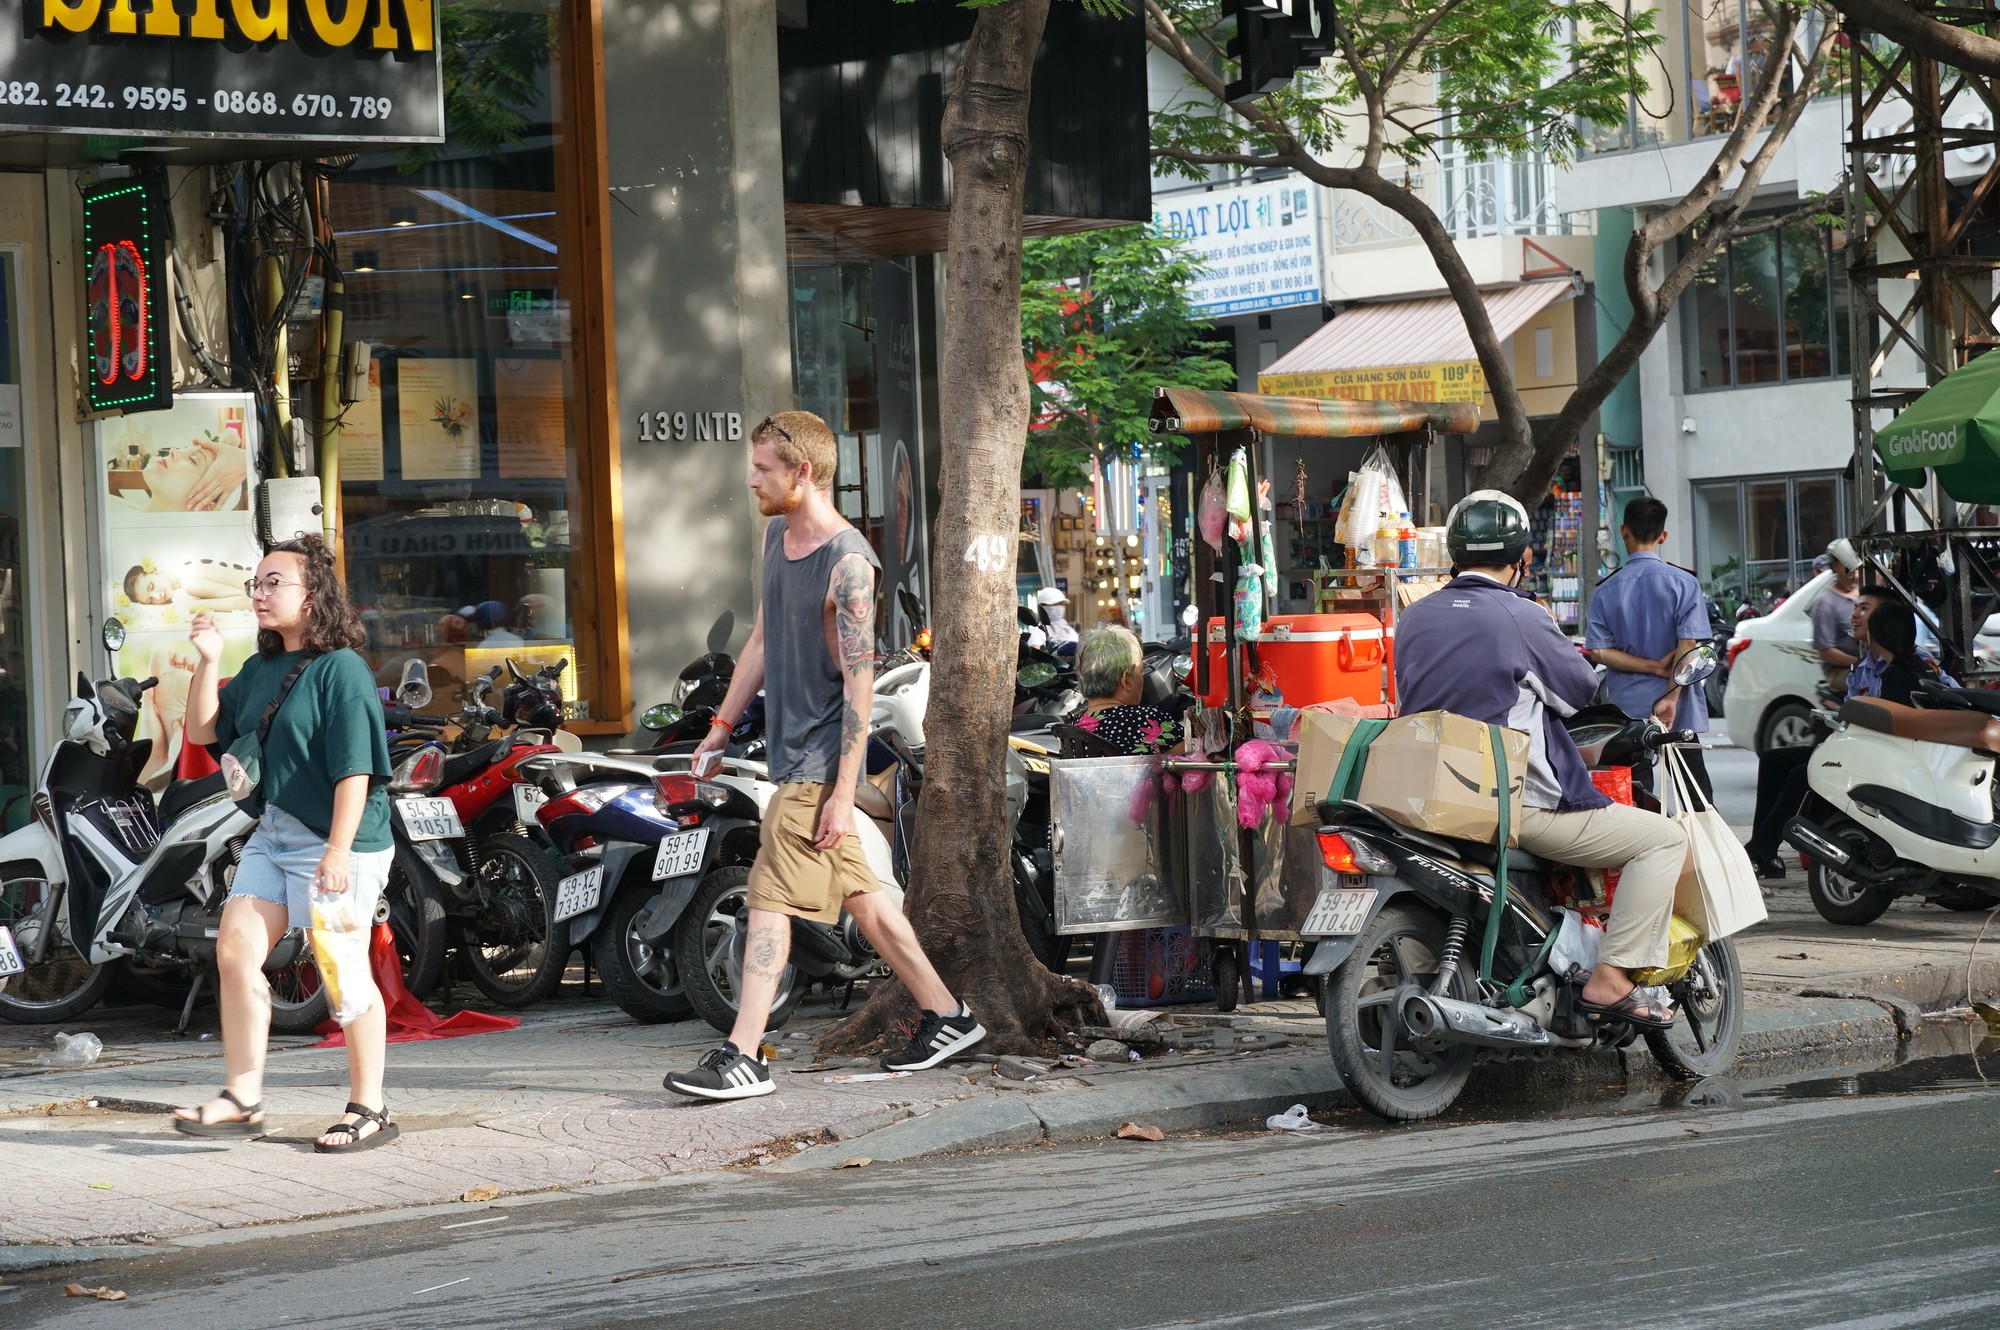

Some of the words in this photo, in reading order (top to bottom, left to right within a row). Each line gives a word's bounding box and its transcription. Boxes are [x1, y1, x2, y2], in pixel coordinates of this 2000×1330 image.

[56, 83, 115, 109] 242.
[123, 86, 187, 111] 9595
[213, 89, 286, 116] 0868.
[292, 93, 343, 118] 670.
[349, 96, 392, 120] 789
[1216, 194, 1250, 238] LỢI
[490, 299, 508, 308] EXIT
[1356, 370, 1383, 383] HÀNG
[1370, 381, 1437, 402] KHANH
[639, 411, 688, 441] 139
[695, 411, 743, 441] NTB
[1889, 424, 1957, 456] GrabFood
[964, 533, 1008, 572] 49
[405, 801, 448, 817] 54-S2
[413, 818, 453, 836] 3057
[666, 832, 699, 856] 59-F1
[657, 851, 700, 877] 901.99
[564, 870, 596, 898] 59-X2
[557, 888, 597, 919] 733.37
[1321, 892, 1366, 911] 59-P1
[1308, 913, 1363, 932] 110.40
